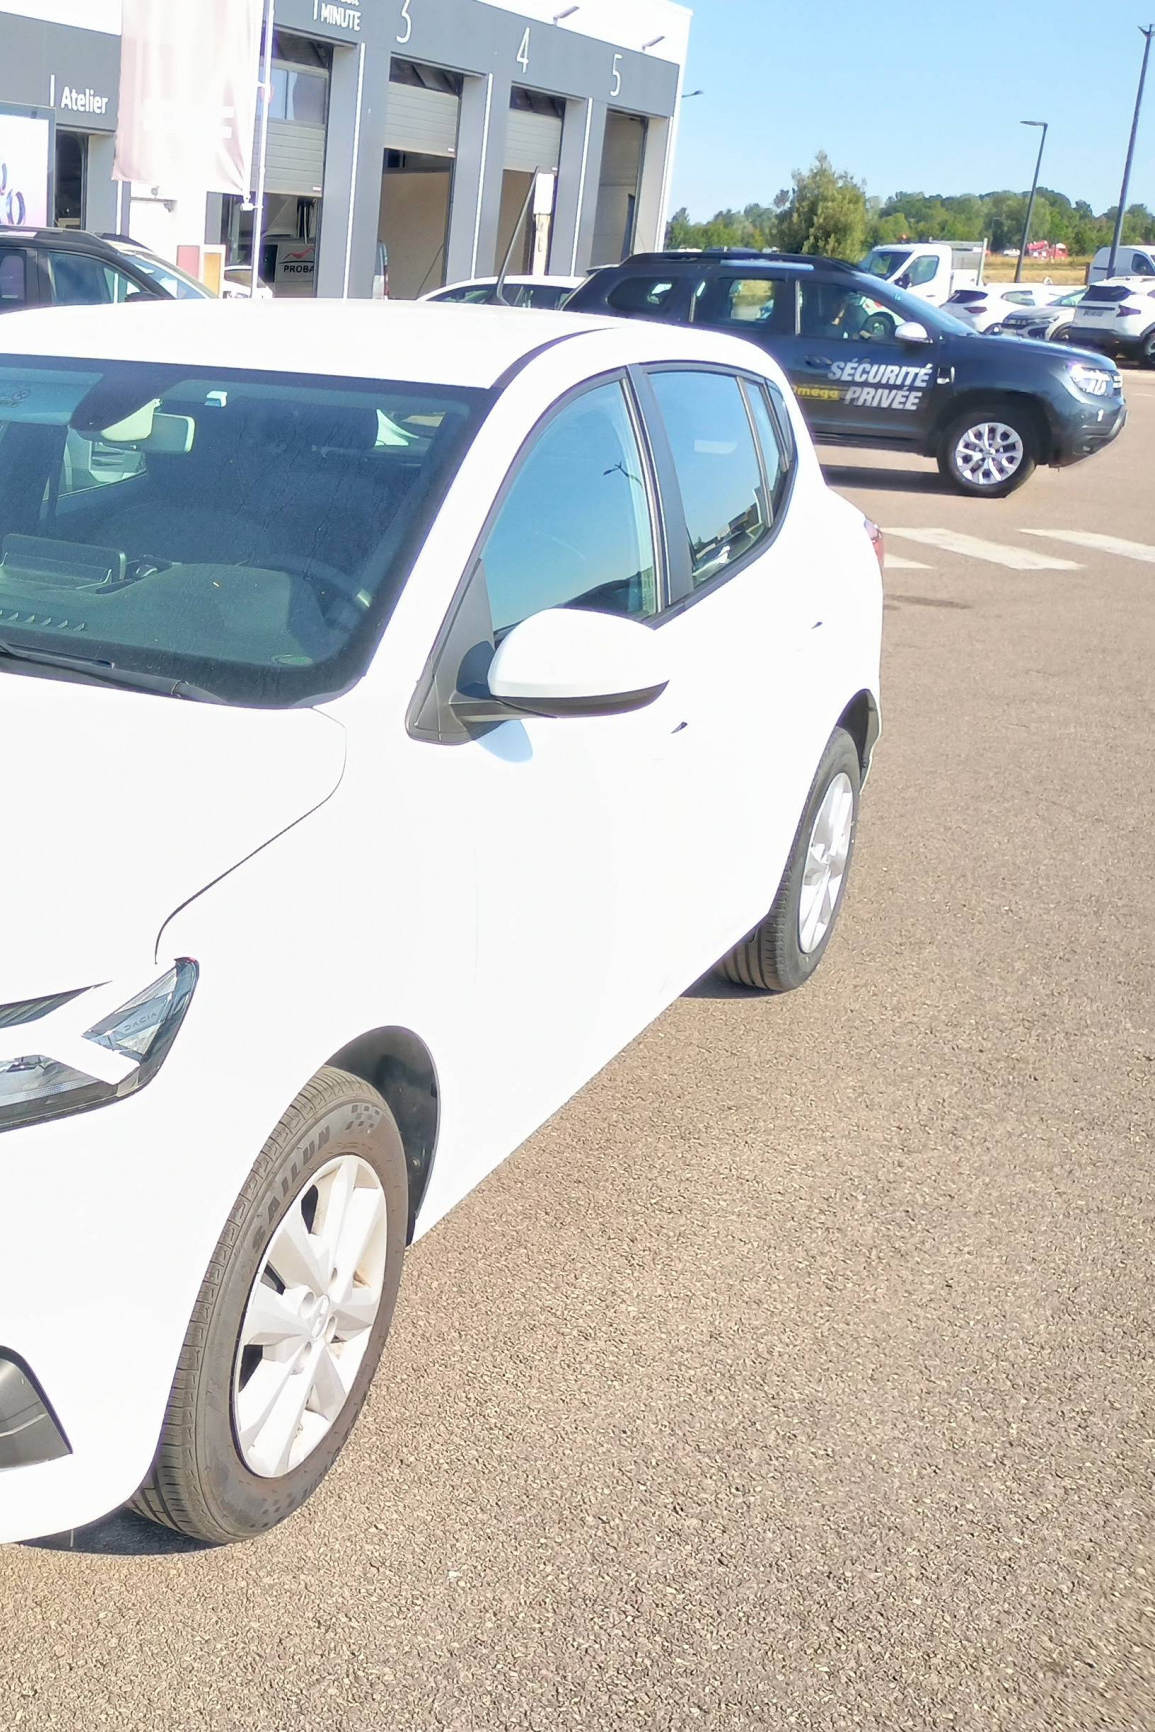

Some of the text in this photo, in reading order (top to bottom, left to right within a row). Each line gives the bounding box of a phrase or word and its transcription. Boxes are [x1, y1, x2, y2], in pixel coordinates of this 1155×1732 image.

[320, 2, 361, 31] MINUTE
[516, 26, 531, 74] 4
[610, 53, 623, 97] 5
[60, 86, 109, 115] Atelier
[827, 358, 933, 388] SÉCURITÉ
[844, 386, 923, 411] PRIVÉE
[252, 1124, 330, 1254] SAILUN
